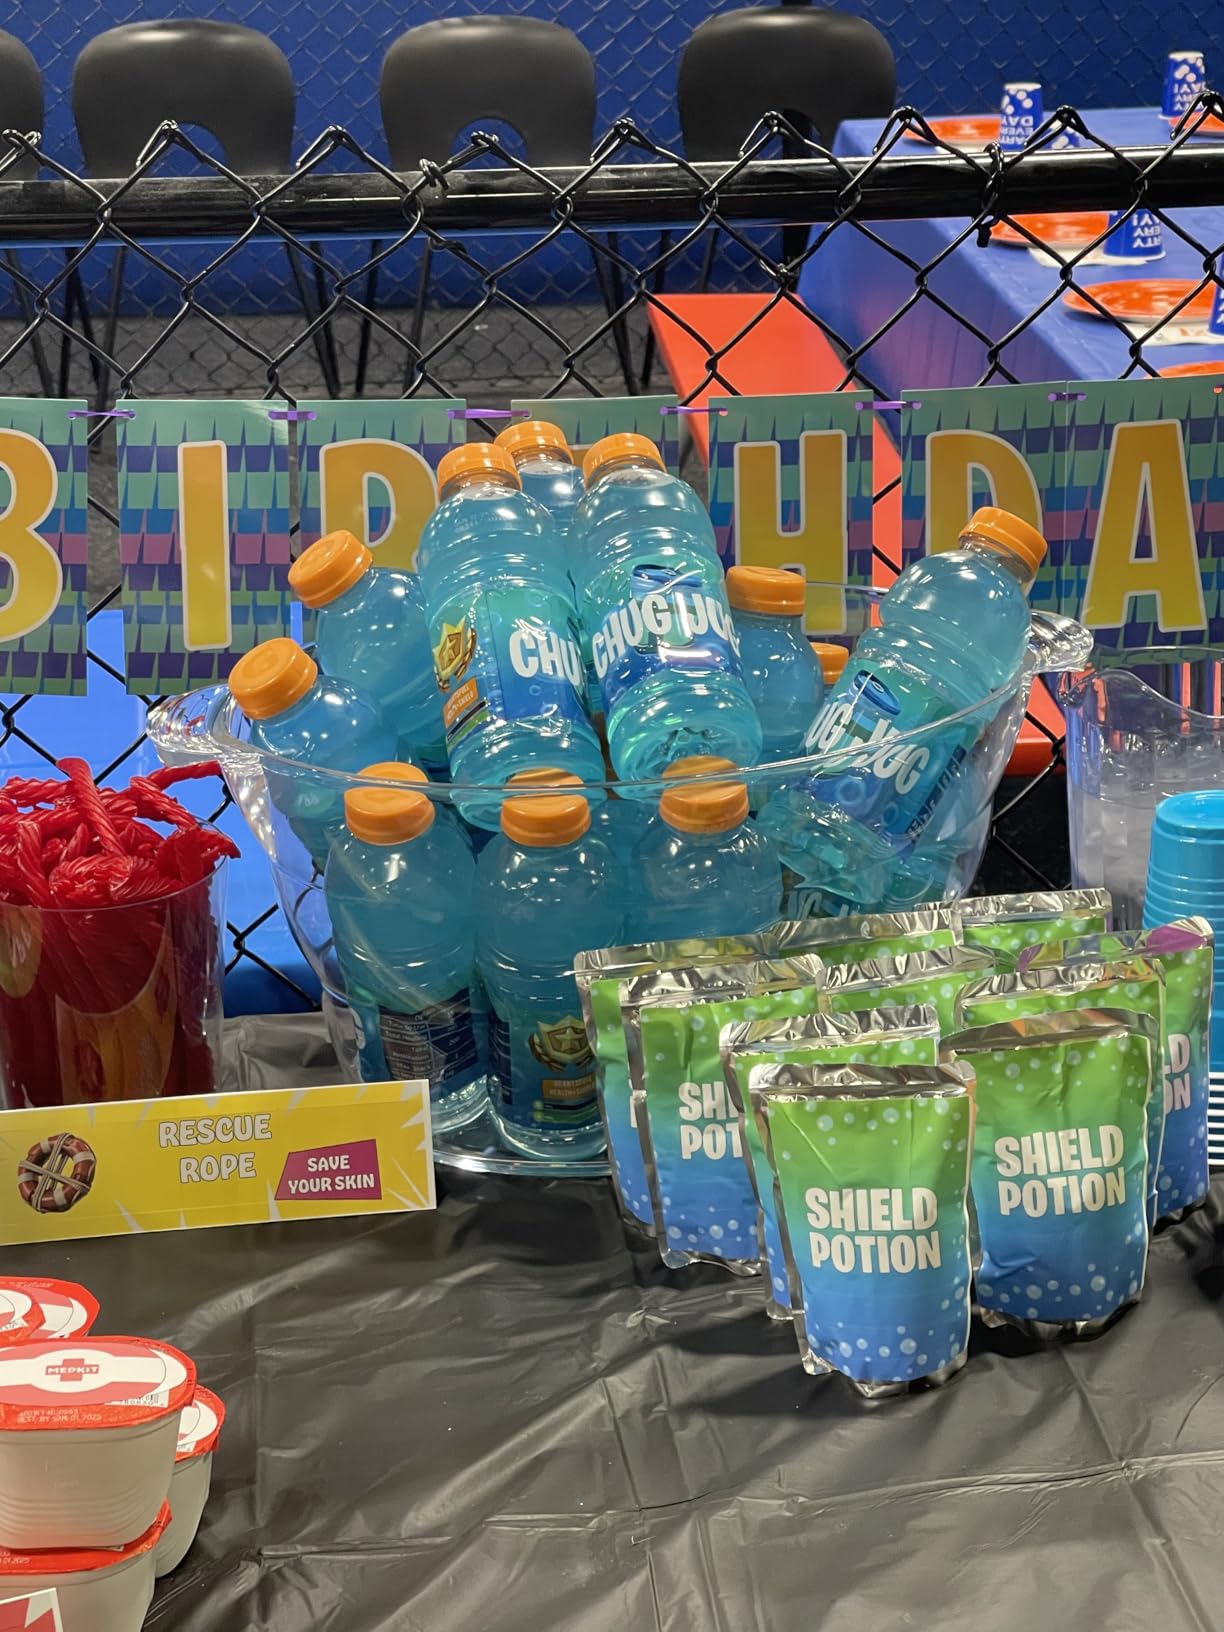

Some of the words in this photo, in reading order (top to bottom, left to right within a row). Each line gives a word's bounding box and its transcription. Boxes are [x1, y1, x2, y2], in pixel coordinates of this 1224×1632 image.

[592, 594, 672, 679] CHUG
[159, 1114, 272, 1148] RESCUE
[179, 1152, 257, 1184] ROPE
[307, 1155, 350, 1172] SAVE
[994, 1125, 1124, 1177] SHIELD
[288, 1178, 332, 1194] YOUR
[335, 1173, 375, 1190] SKIN
[998, 1167, 1126, 1218] POTION
[805, 1187, 938, 1232] SHIELD
[809, 1231, 942, 1273] POTION
[47, 1366, 99, 1374] MEDKIT
